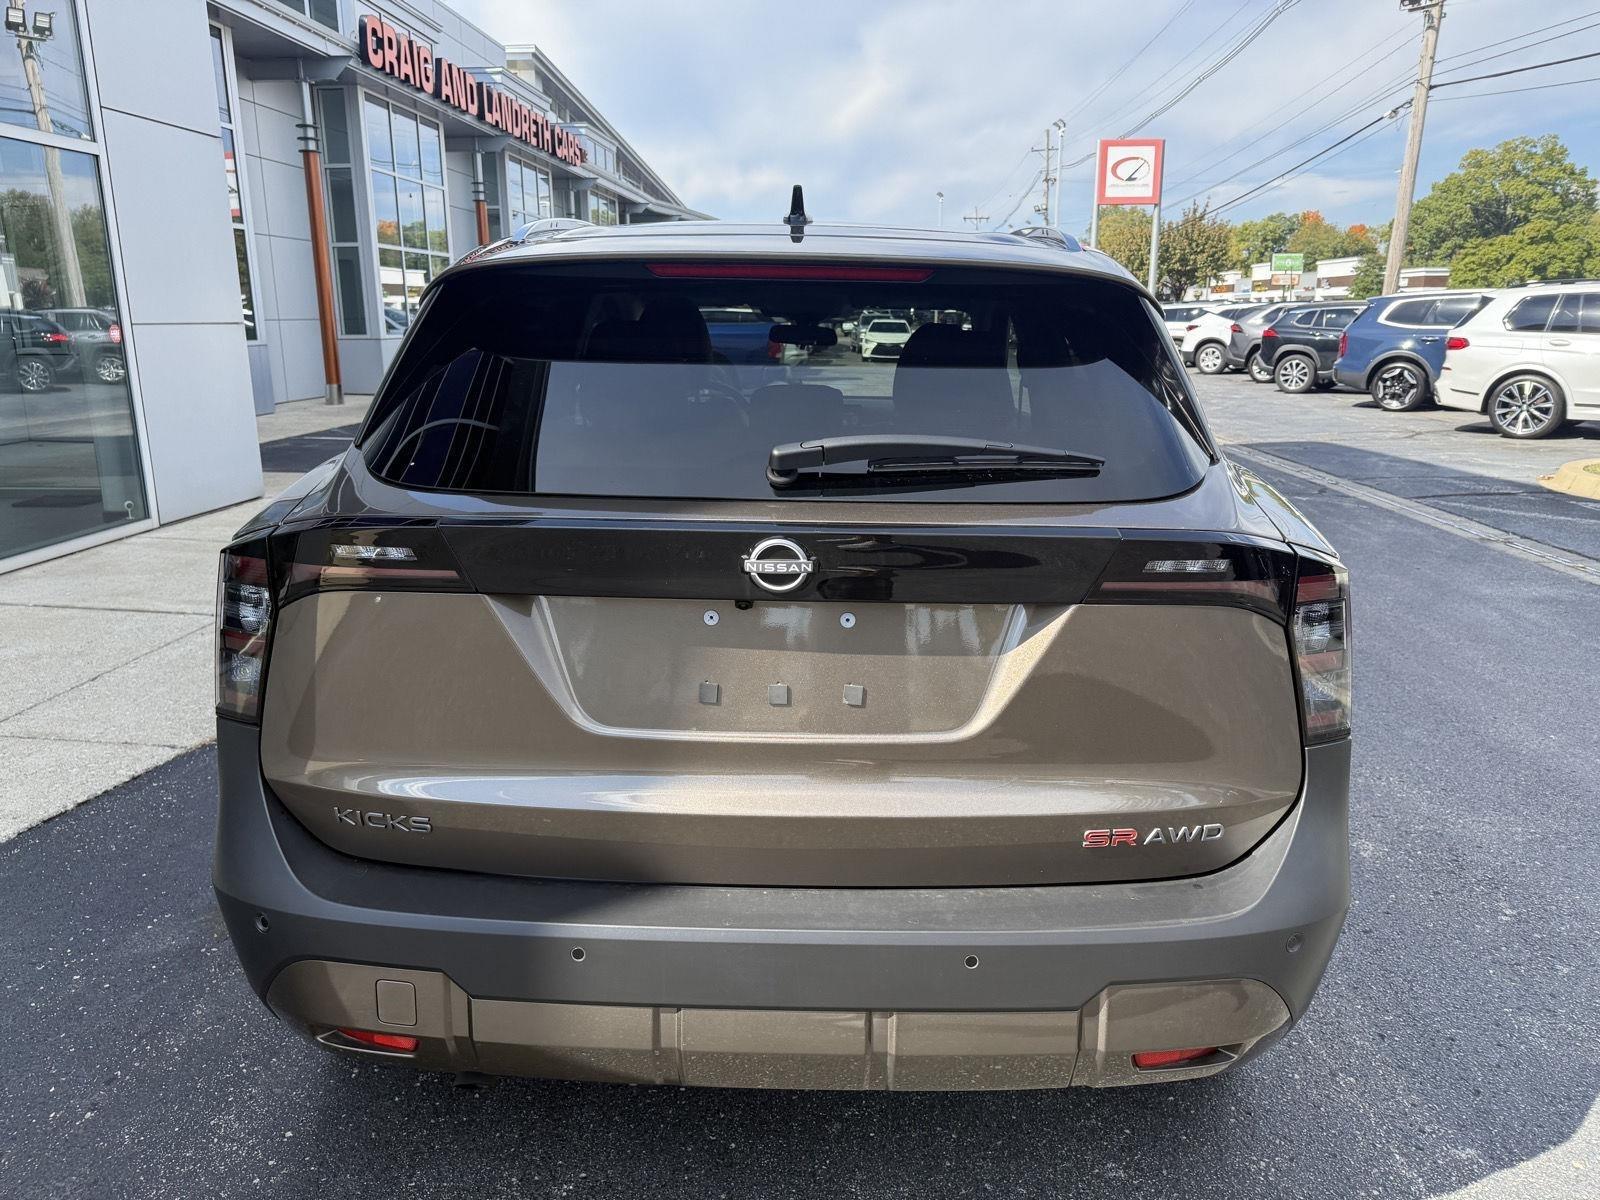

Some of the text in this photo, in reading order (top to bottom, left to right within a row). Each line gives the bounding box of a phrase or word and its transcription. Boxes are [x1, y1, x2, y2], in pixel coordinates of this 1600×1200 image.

[363, 14, 581, 167] CRAIG AND LANDRETH CARS
[746, 562, 812, 573] NISSAN
[333, 806, 433, 833] KICKS
[1082, 823, 1225, 848] SR AWD
